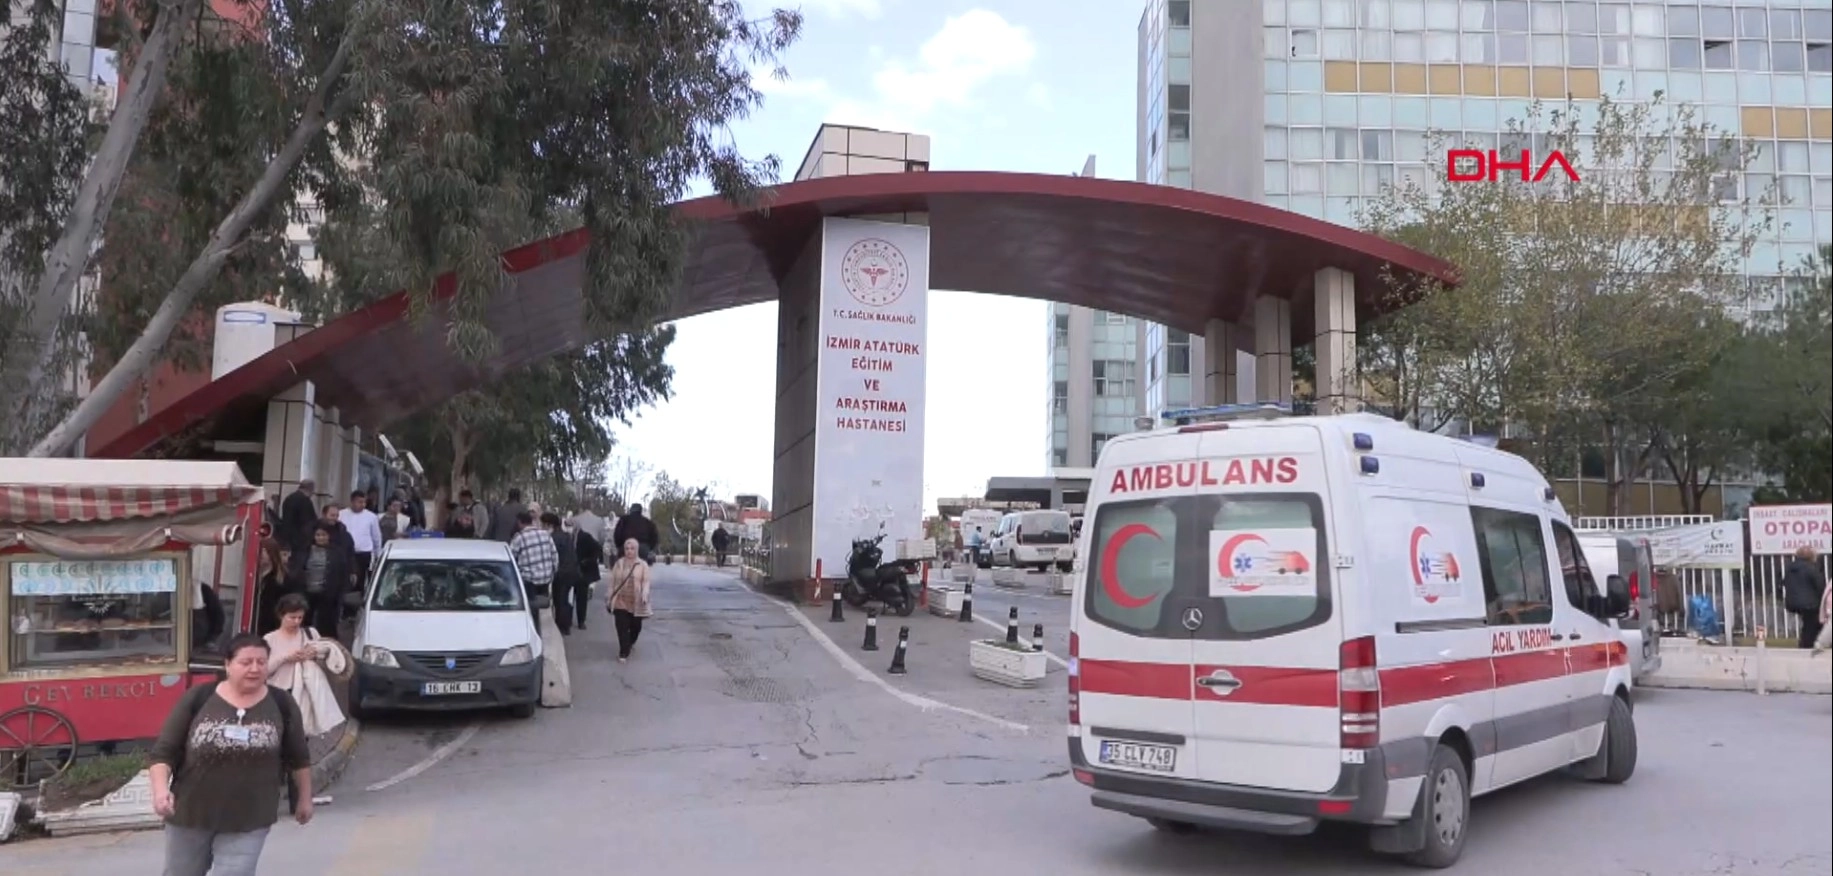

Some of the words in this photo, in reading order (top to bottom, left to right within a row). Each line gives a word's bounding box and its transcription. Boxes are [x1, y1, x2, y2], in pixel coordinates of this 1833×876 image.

[848, 309, 874, 321] SAĞLIK
[876, 313, 916, 324] BAKANLIĞI
[826, 335, 861, 350] İZMİR
[851, 356, 893, 372] EĞİTİM
[864, 379, 880, 391] VE
[836, 397, 907, 414] ARAŞTIRMA
[837, 417, 906, 432] HASTANESİ
[1110, 457, 1298, 494] AMBULANS
[1149, 748, 1171, 764] 748
